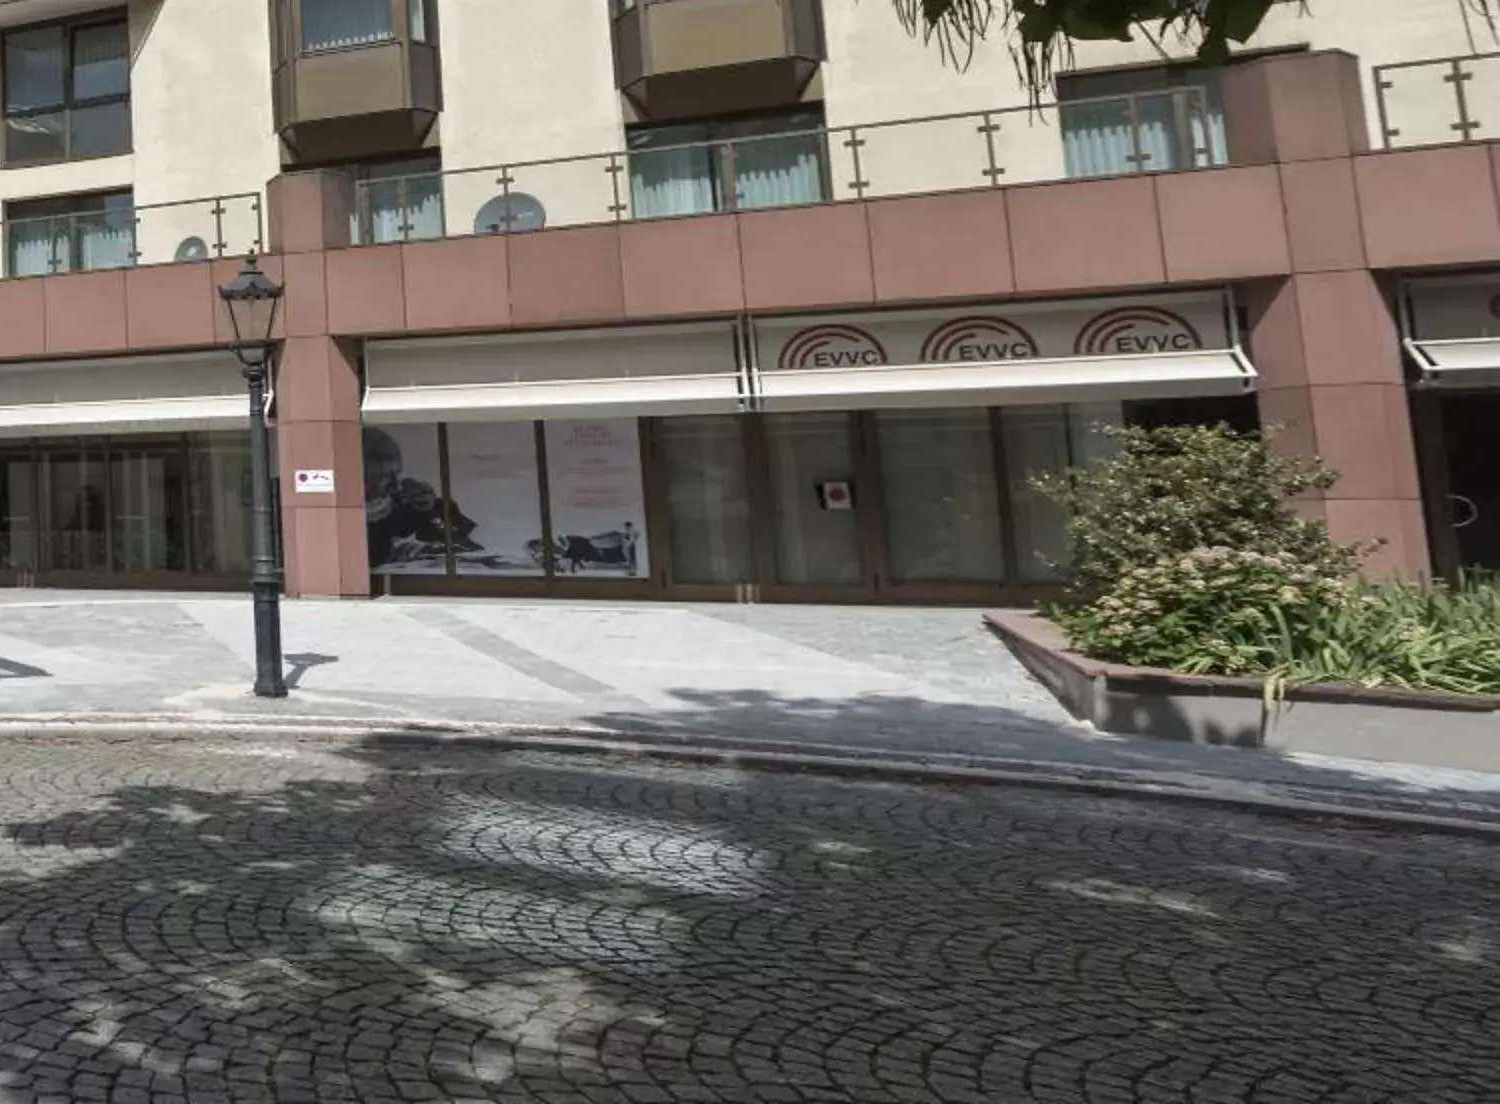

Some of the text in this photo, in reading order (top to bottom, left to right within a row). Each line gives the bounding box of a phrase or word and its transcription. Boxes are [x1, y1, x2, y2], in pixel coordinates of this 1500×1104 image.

[958, 342, 1030, 362] EVVC
[1115, 333, 1191, 353] EVVC
[813, 349, 878, 368] EVVC
